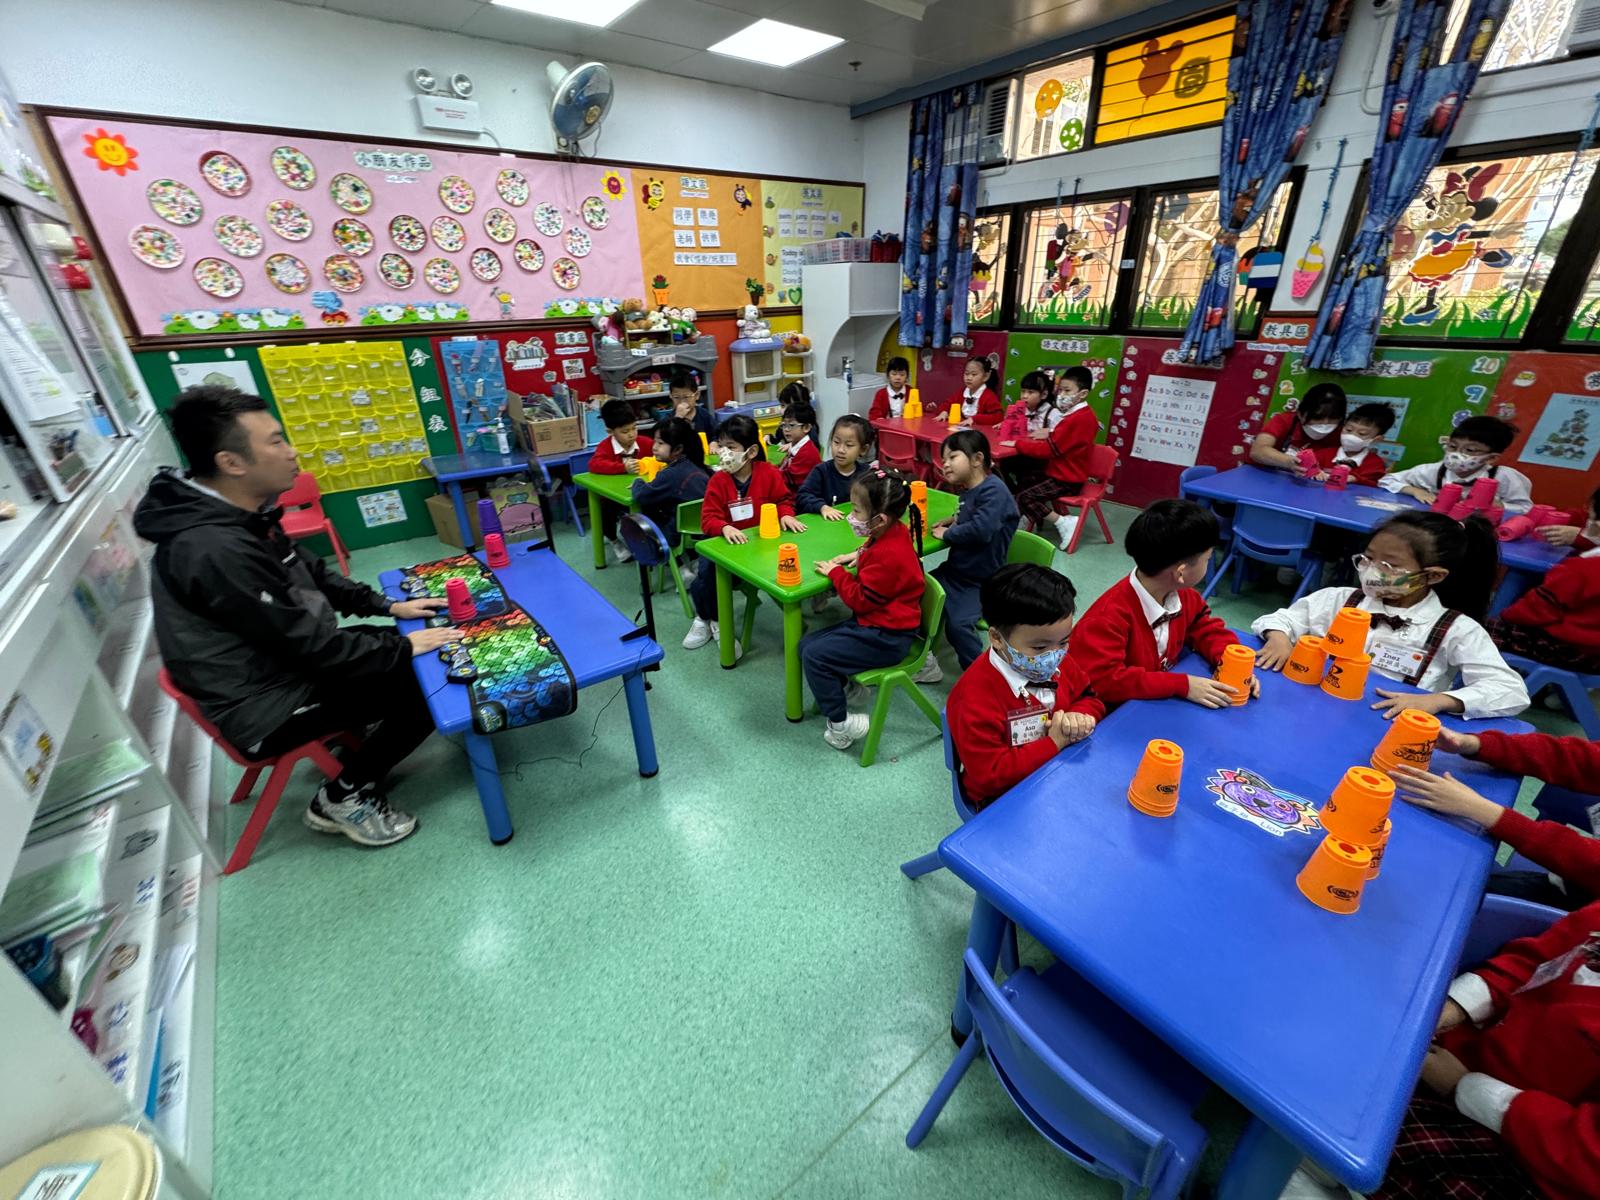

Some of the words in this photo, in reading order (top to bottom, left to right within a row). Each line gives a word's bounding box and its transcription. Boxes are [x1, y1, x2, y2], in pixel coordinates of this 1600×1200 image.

[1264, 324, 1308, 338] 教具區
[1472, 356, 1500, 374] 10
[1279, 380, 1294, 395] 2
[1464, 385, 1488, 403] 9
[1383, 652, 1400, 662] Inez
[1260, 821, 1282, 835] Lion
